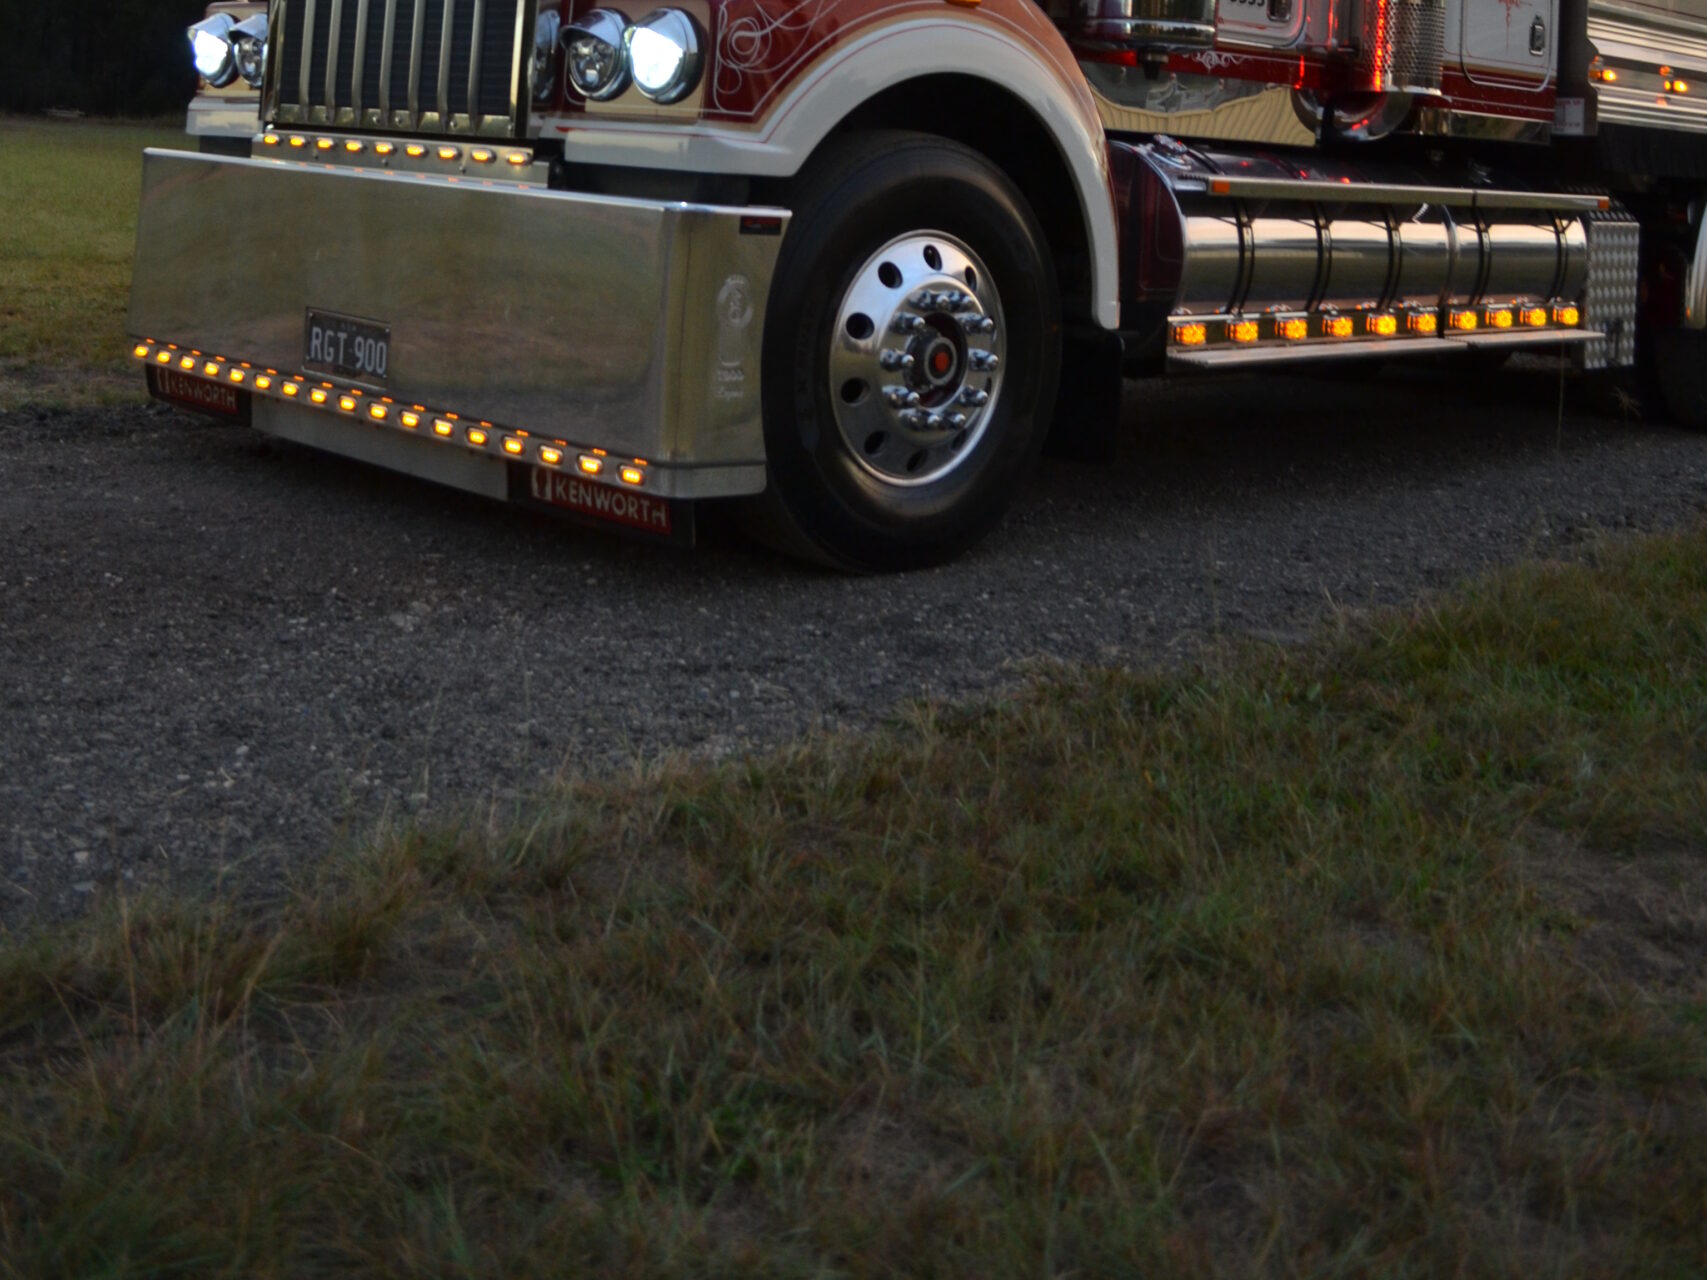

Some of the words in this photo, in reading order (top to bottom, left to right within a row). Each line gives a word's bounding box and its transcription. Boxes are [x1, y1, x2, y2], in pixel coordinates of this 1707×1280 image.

[310, 326, 348, 366] RGT
[354, 335, 387, 375] 900
[170, 375, 236, 409] KENWORTH
[555, 475, 667, 527] KENWORTH
